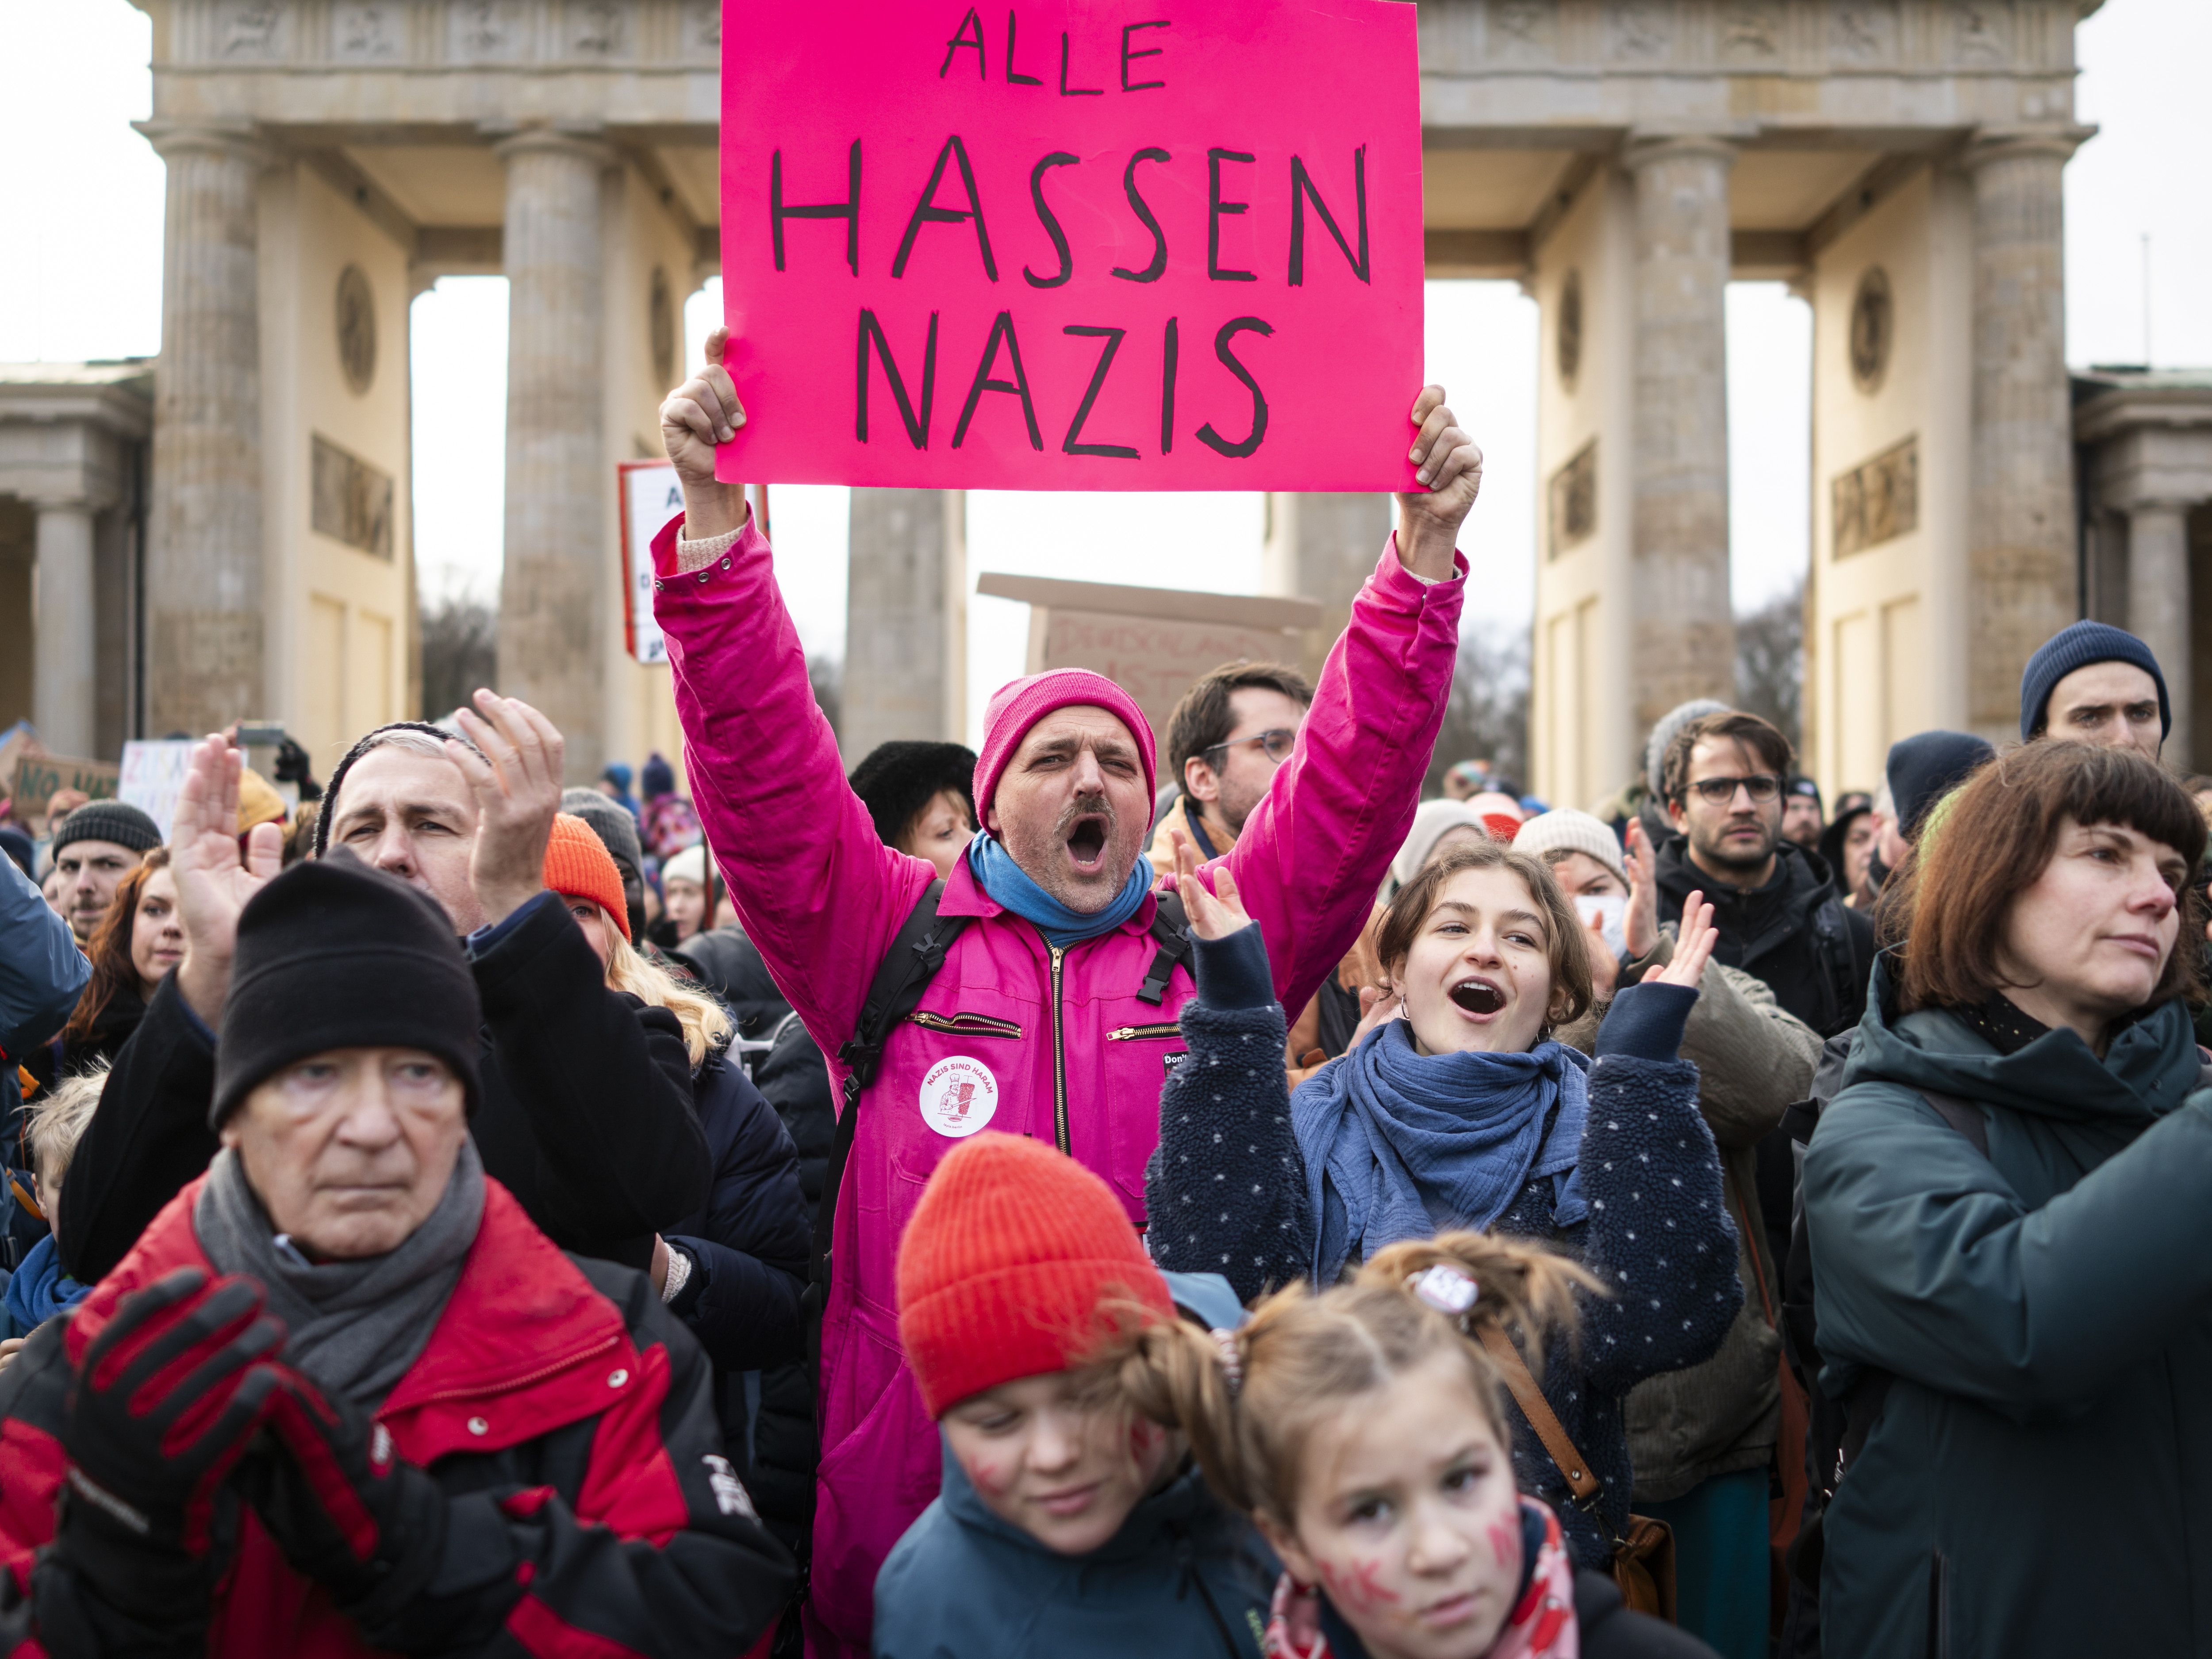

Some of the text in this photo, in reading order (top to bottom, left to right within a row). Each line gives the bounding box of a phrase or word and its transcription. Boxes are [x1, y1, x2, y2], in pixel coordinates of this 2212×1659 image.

[941, 8, 1171, 96] ALLE
[771, 136, 1370, 288] HASSEN
[856, 309, 1274, 460] NAZIS
[19, 761, 60, 800] NO
[927, 1066, 949, 1086] NAZIS
[972, 1067, 993, 1094] HARAM
